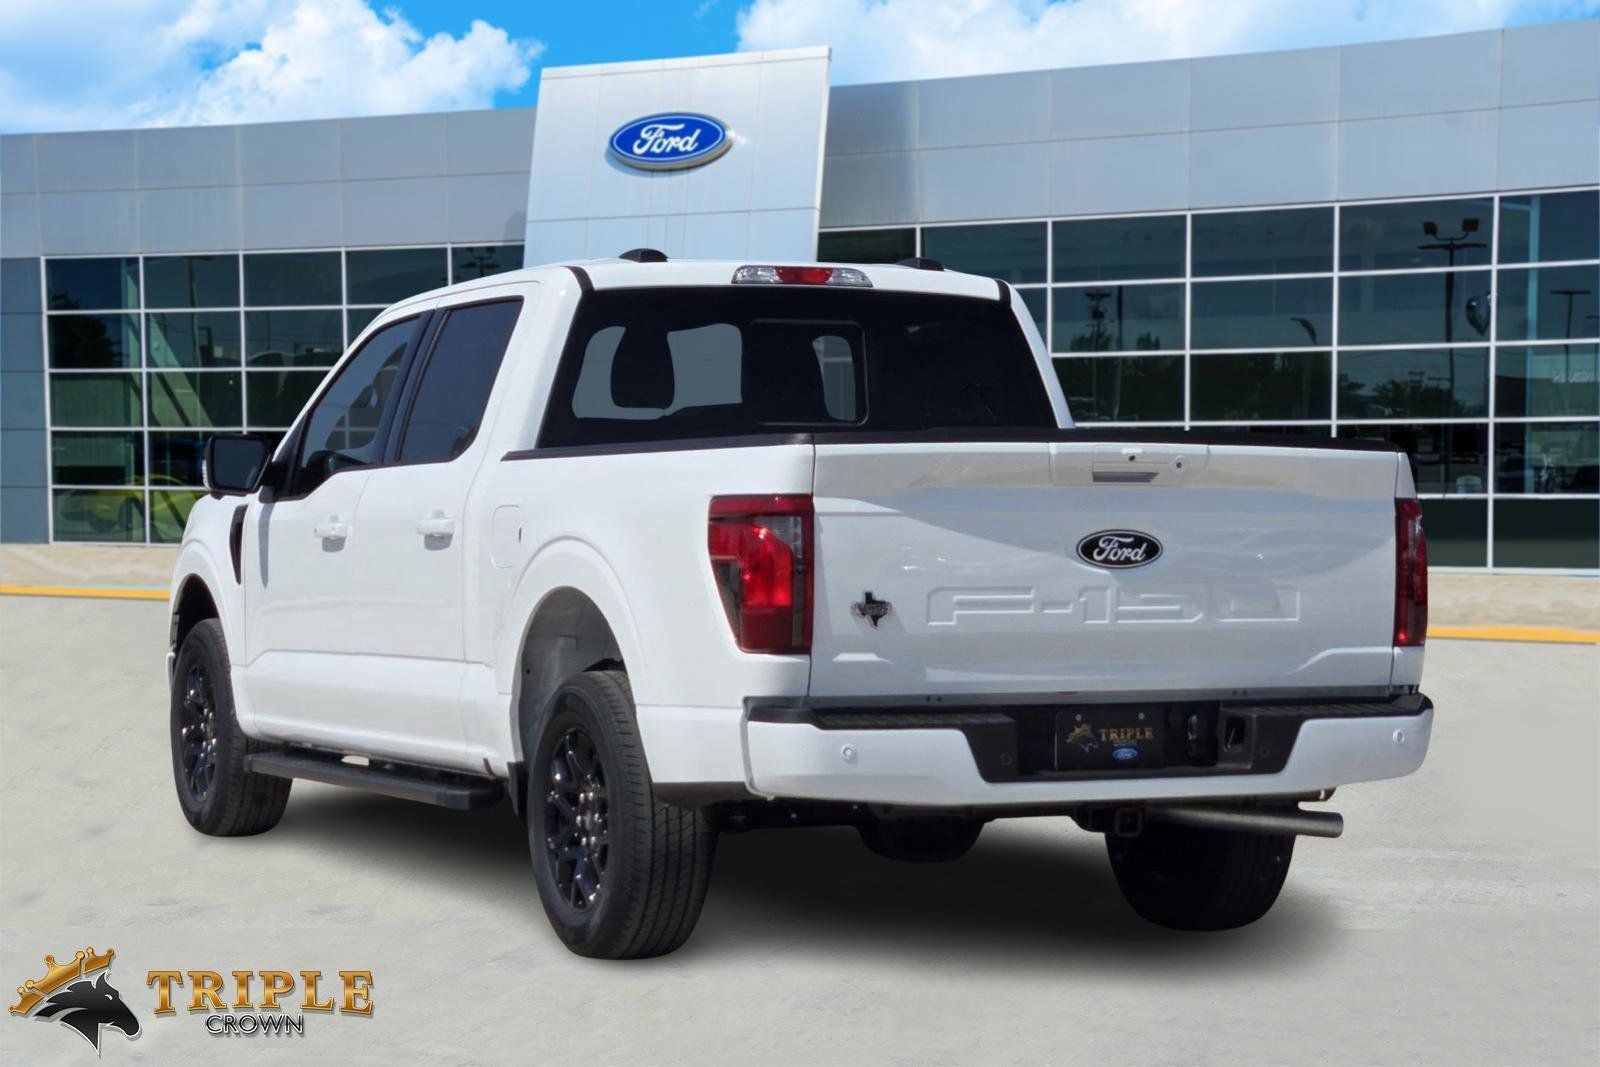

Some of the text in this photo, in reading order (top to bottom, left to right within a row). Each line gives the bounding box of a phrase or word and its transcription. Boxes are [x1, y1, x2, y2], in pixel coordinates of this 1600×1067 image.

[632, 123, 701, 155] Ford
[1093, 535, 1148, 561] Ford
[926, 586, 1300, 626] F-150
[1099, 727, 1153, 742] TRIPLE
